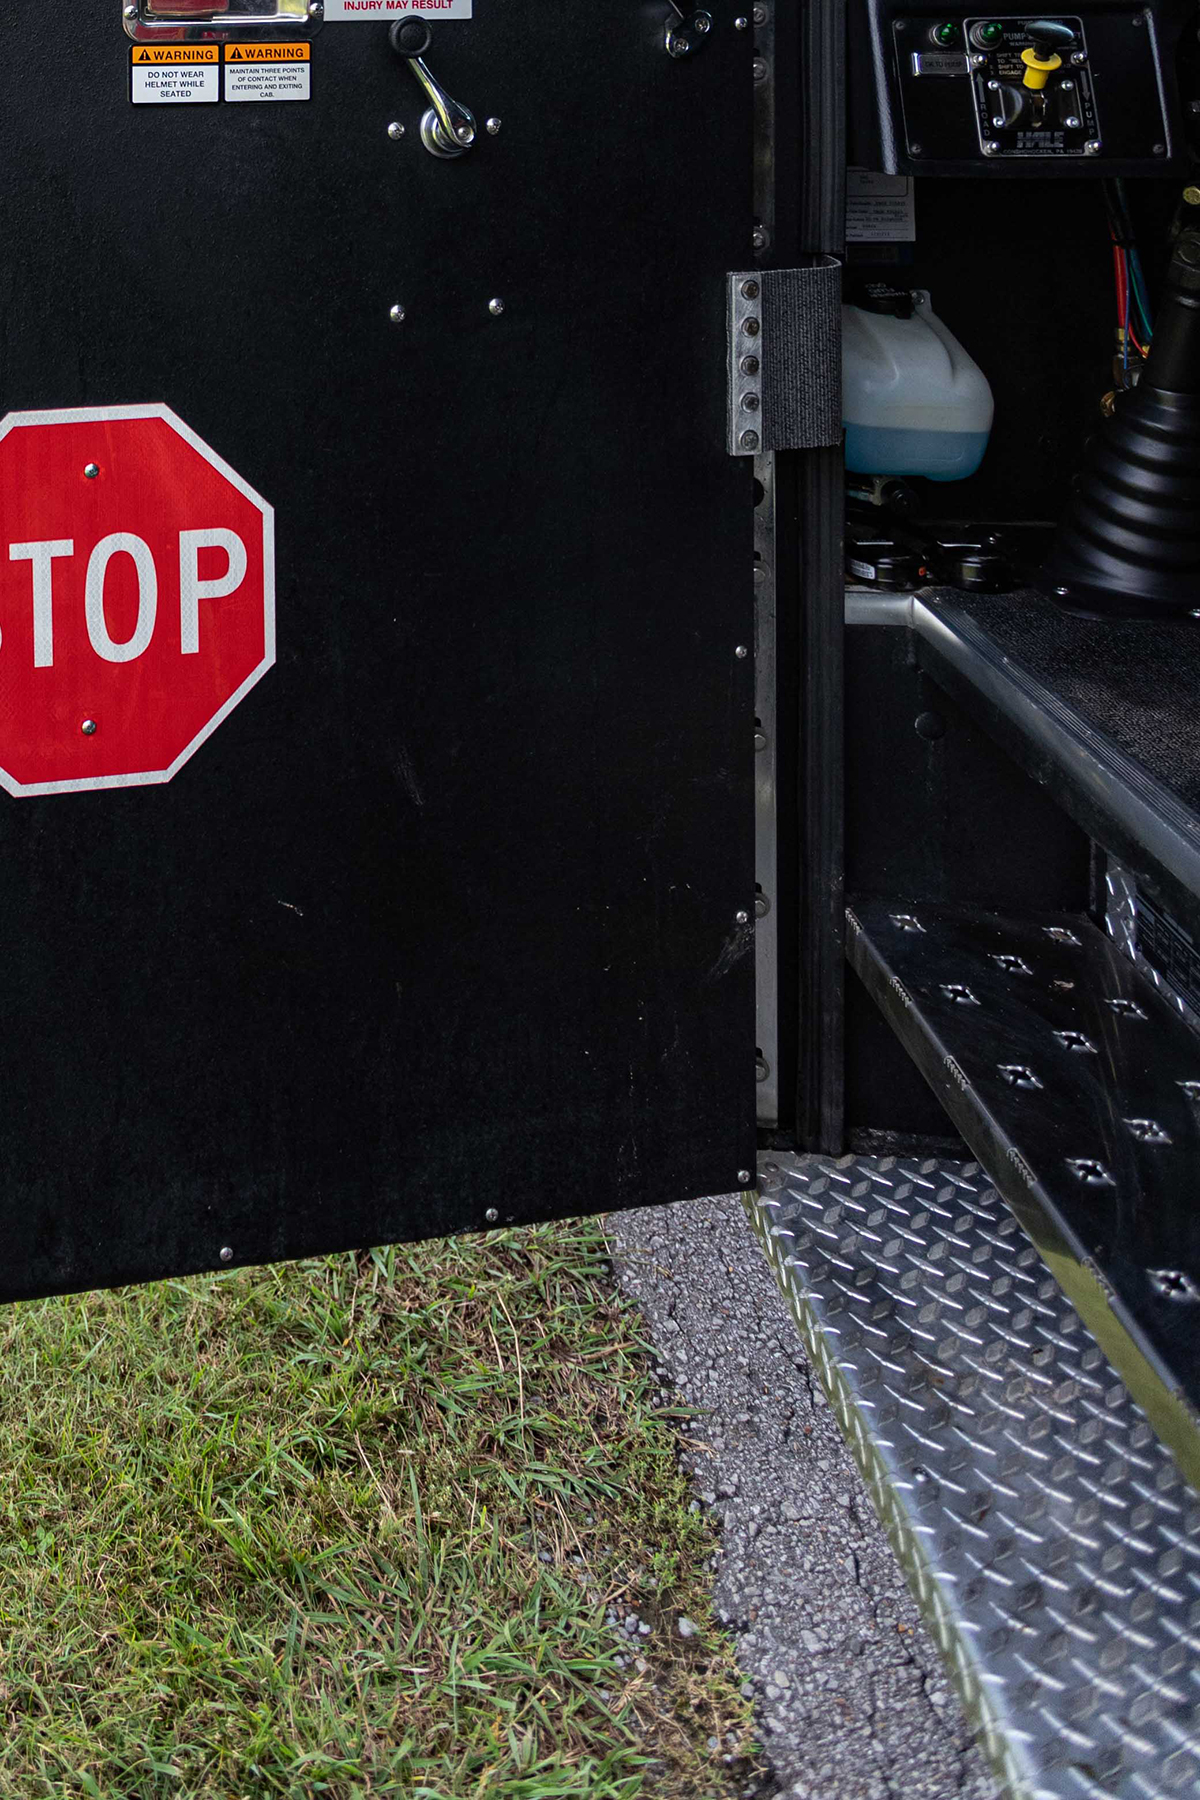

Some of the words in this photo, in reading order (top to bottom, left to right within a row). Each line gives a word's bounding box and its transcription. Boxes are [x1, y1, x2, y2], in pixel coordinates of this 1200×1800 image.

[343, 0, 383, 11] INJURY
[386, 0, 409, 10] MAY
[411, 0, 454, 10] RESULT
[1003, 32, 1026, 41] PUMP
[153, 50, 214, 61] WARNING
[244, 48, 304, 59] WARNING
[147, 71, 160, 79] DO
[161, 71, 179, 79] NOT
[179, 70, 204, 78] WEAR
[144, 80, 178, 89] HELMET
[179, 80, 205, 88] WHILE
[160, 90, 192, 98] SEATED
[980, 103, 991, 136] ROAD
[1084, 102, 1095, 136] PUMP
[1016, 131, 1065, 149] HALE
